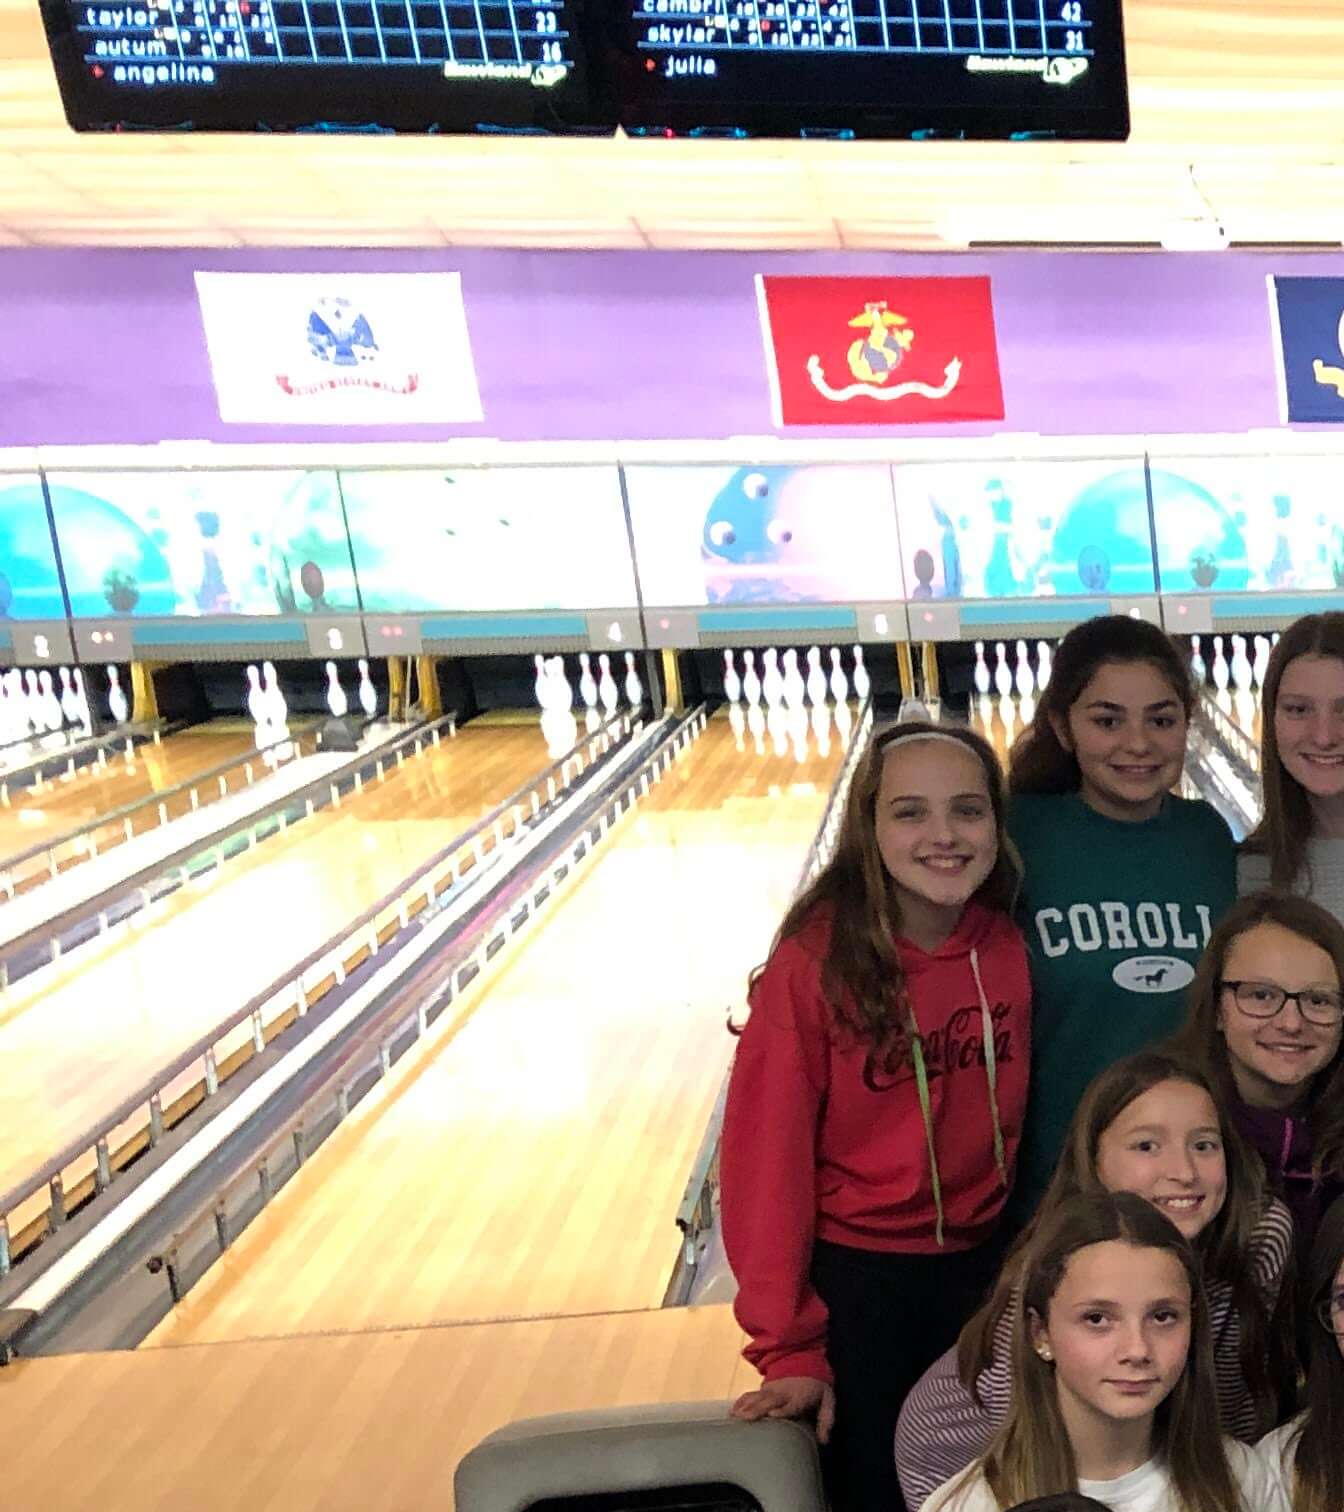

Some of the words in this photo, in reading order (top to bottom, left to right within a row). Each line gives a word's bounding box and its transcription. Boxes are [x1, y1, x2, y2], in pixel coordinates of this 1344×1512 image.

[87, 7, 159, 29] taylor
[648, 23, 715, 47] skylar
[95, 38, 167, 56] autum
[113, 62, 216, 84] angelina
[664, 55, 717, 78] julia
